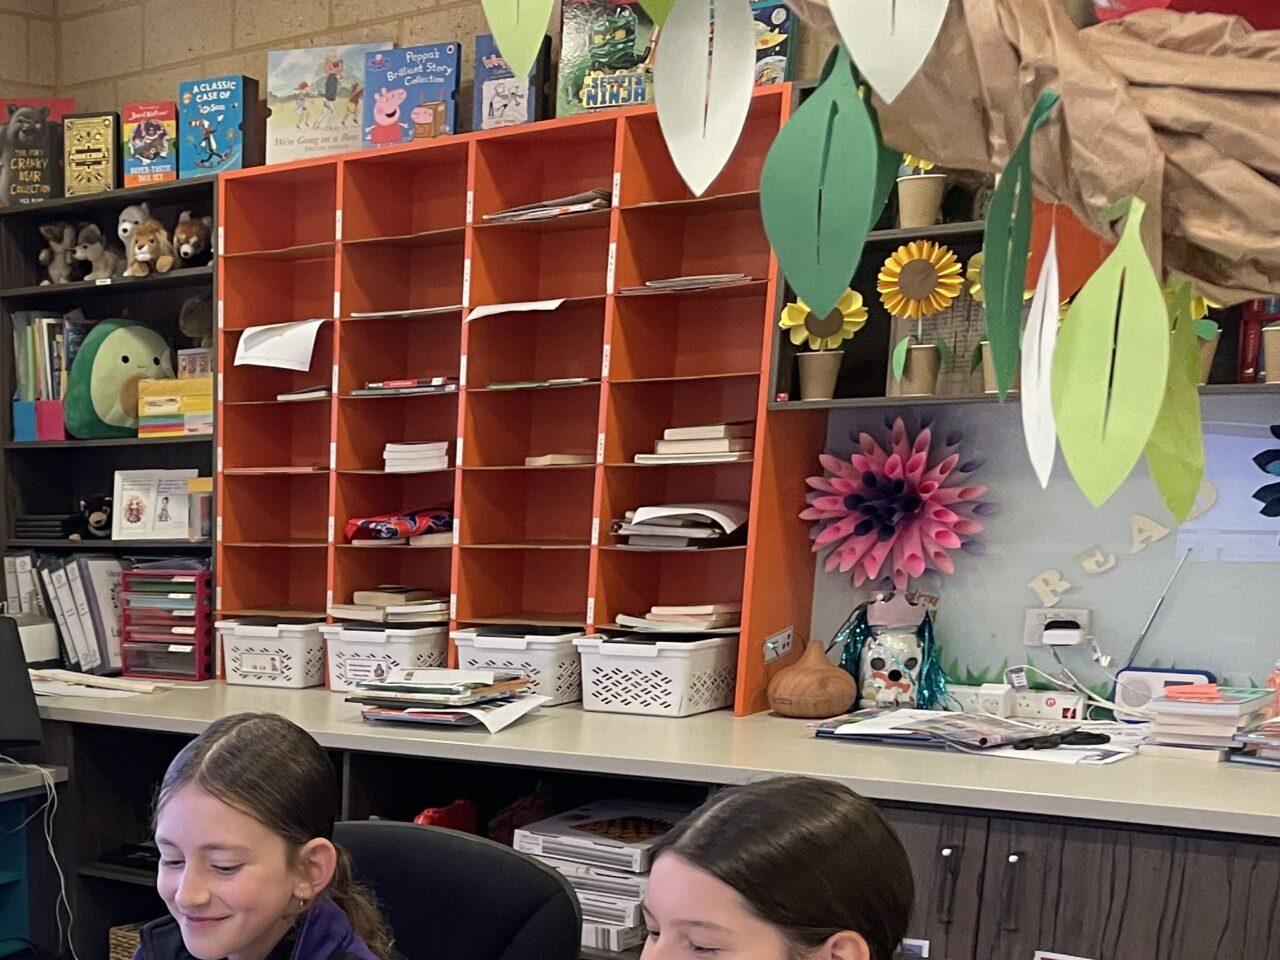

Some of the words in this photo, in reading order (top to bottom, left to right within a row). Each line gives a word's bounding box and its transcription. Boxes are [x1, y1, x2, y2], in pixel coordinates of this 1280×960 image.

[426, 62, 453, 76] Story
[192, 85, 200, 93] A
[200, 81, 237, 92] CLASSIC
[196, 91, 218, 102] CASE
[219, 91, 231, 99] OF
[586, 86, 647, 107] NINJA
